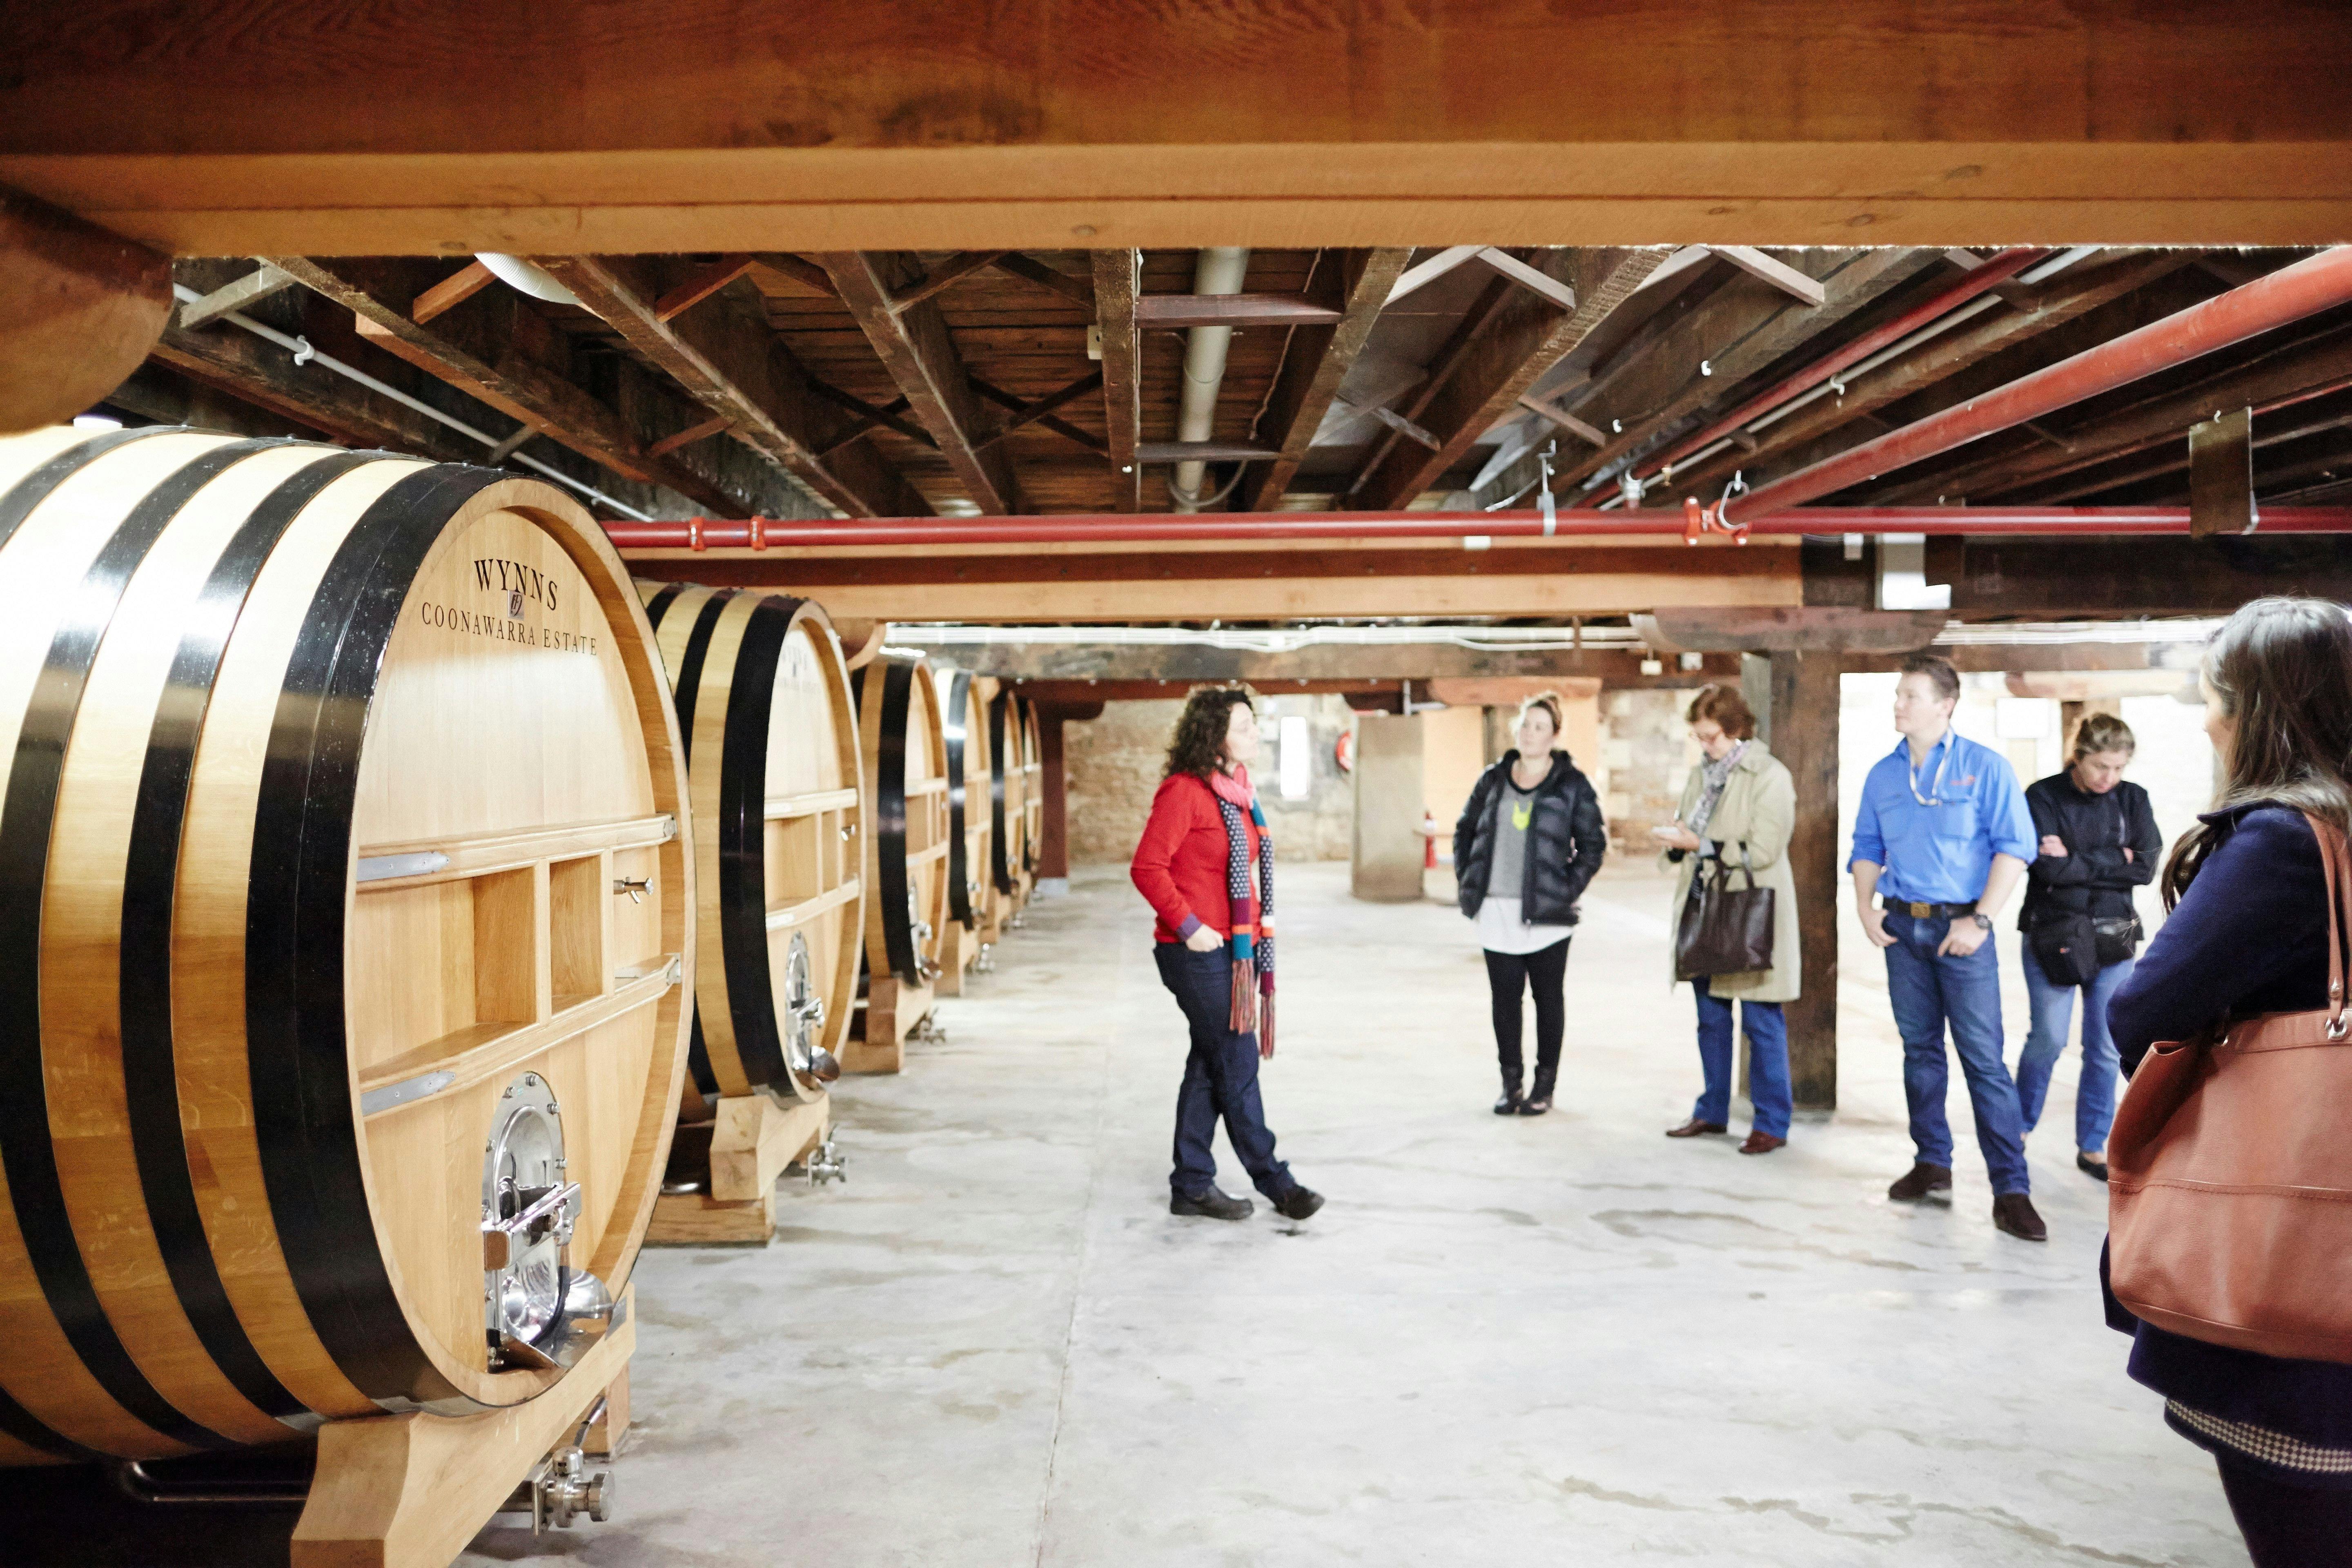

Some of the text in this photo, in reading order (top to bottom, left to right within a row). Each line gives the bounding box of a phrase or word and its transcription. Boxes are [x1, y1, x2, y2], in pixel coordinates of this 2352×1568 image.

[474, 559, 557, 610] WYNNS
[422, 602, 535, 645] COONAWARRA
[543, 629, 597, 655] ESTATE
